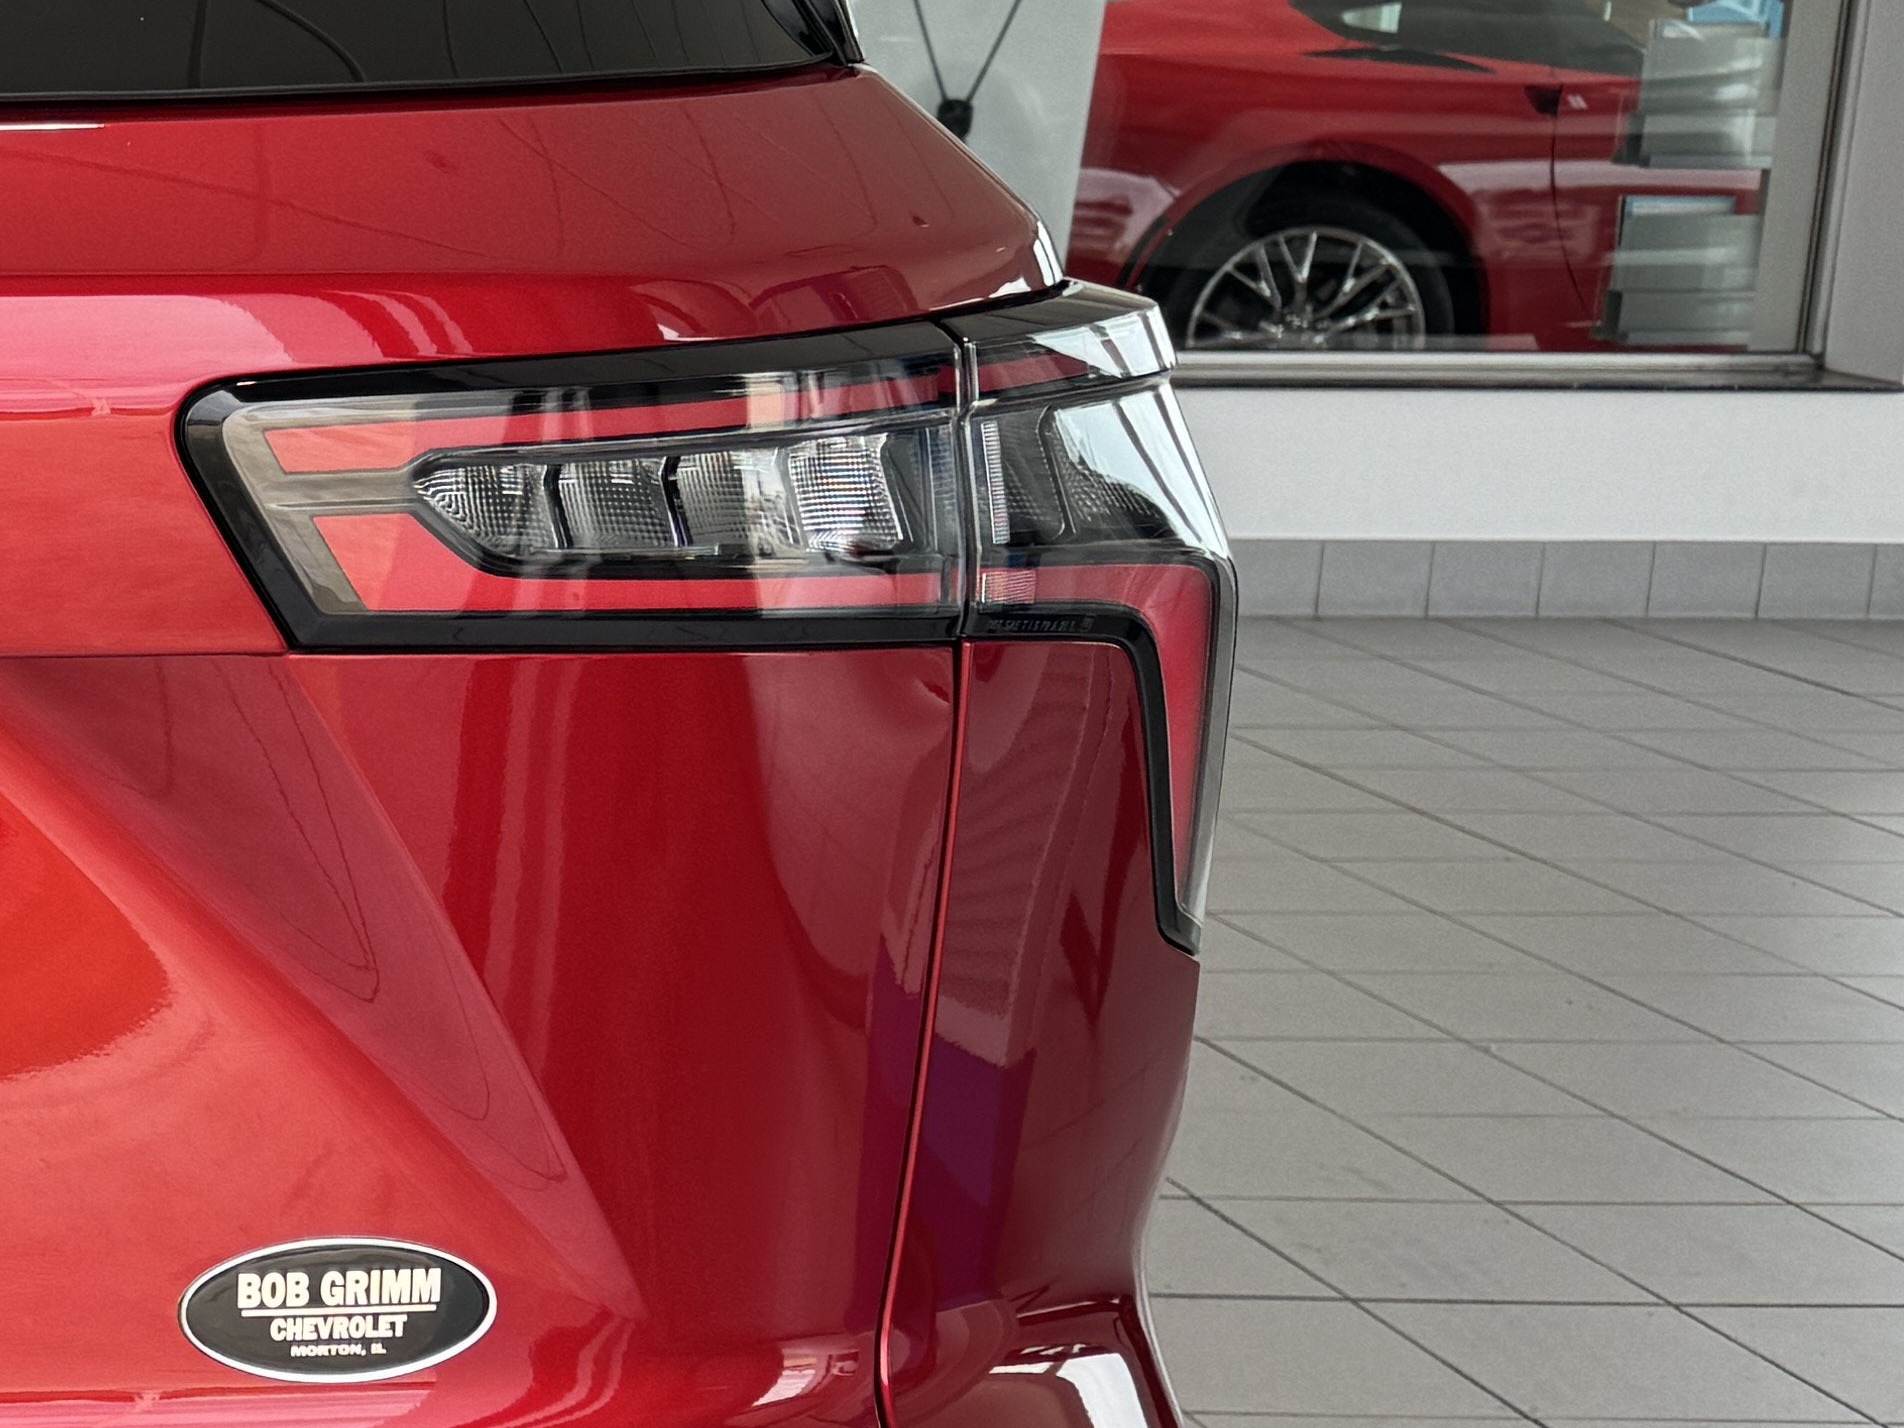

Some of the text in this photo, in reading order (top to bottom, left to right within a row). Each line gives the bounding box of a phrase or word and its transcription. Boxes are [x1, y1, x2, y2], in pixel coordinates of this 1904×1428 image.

[237, 1267, 441, 1309] BOB GRIMM
[270, 1314, 408, 1342] CHEVROLET
[291, 1344, 367, 1358] MORTON,
